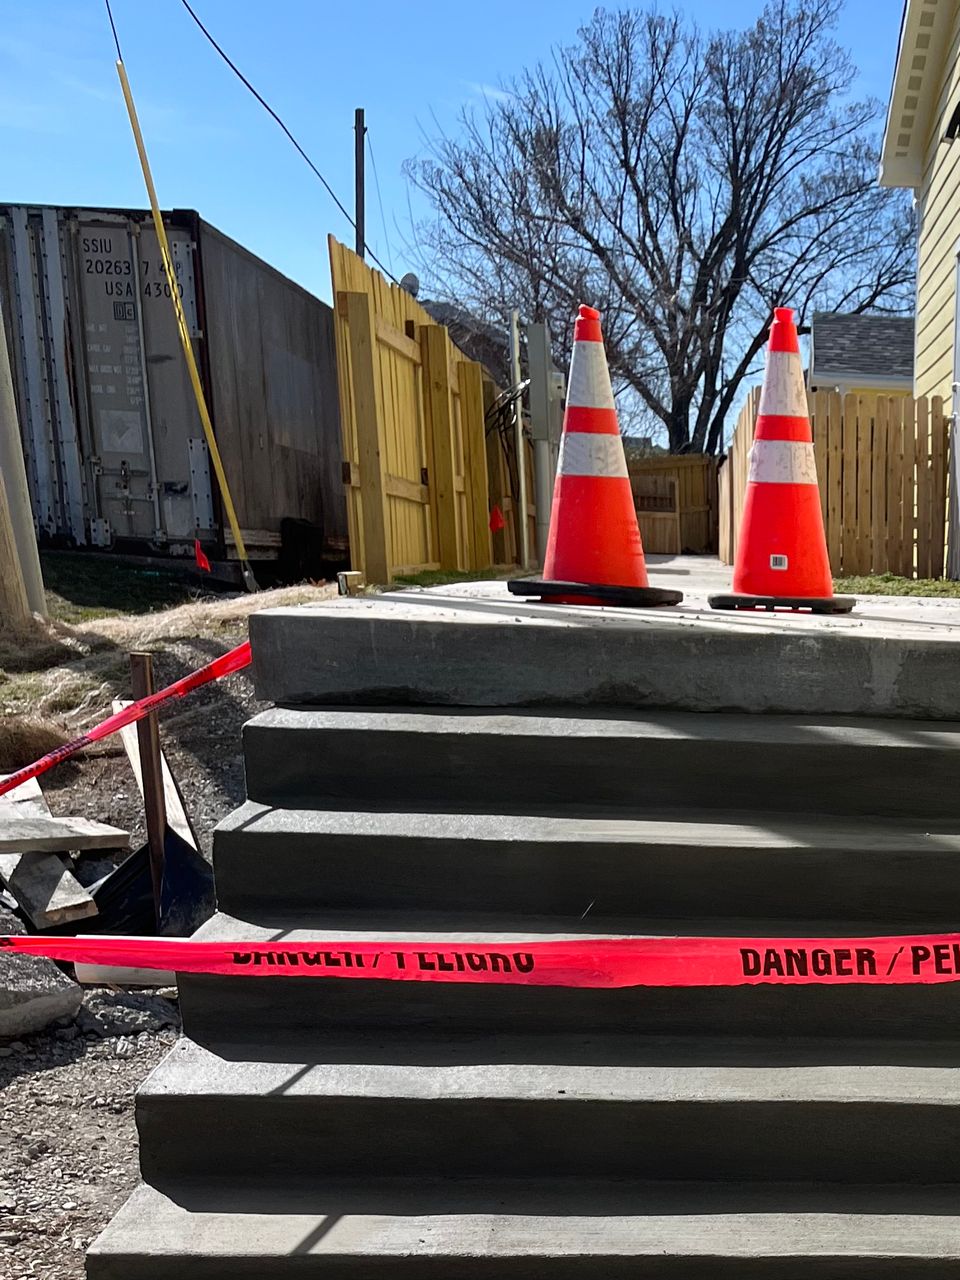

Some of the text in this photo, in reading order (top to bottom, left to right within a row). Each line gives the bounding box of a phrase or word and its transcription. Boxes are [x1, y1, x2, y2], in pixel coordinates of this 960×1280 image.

[83, 238, 112, 254] SSIU
[105, 281, 133, 297] USA
[740, 948, 877, 976] DANGER
